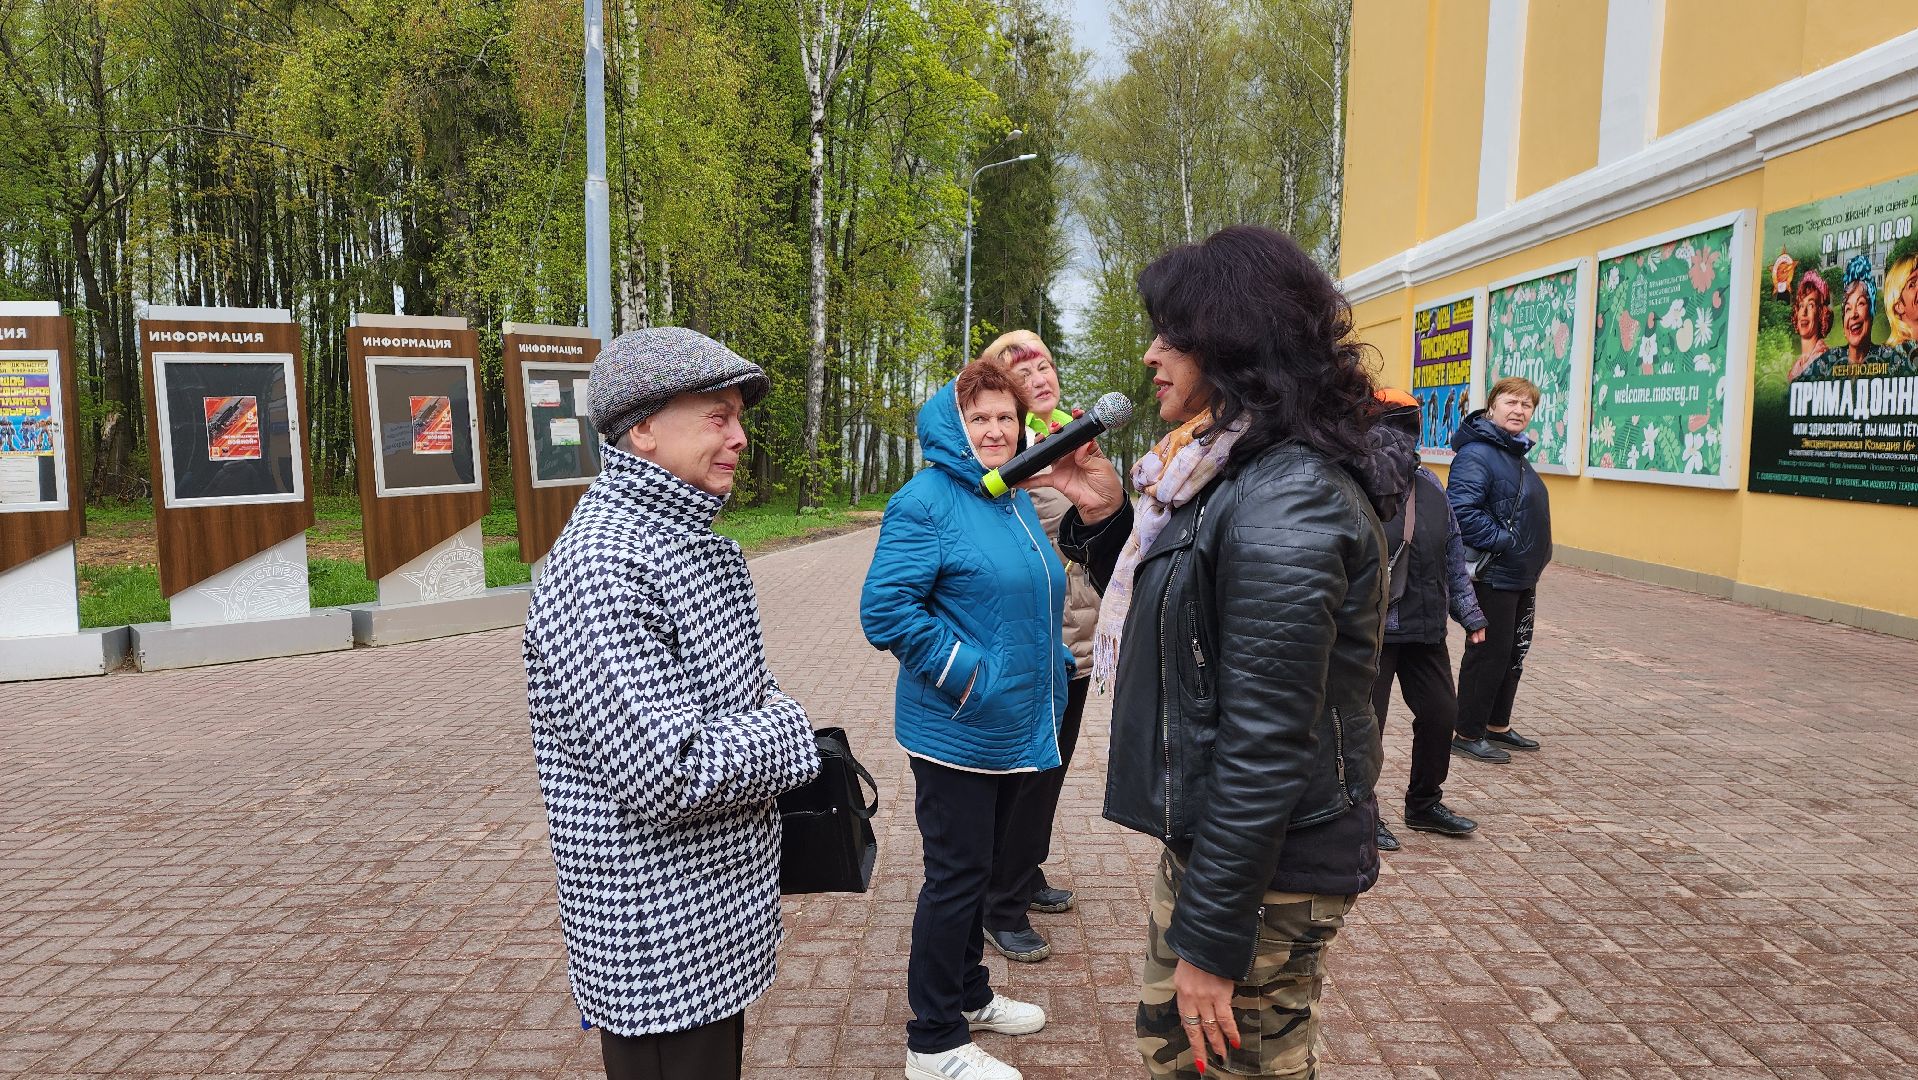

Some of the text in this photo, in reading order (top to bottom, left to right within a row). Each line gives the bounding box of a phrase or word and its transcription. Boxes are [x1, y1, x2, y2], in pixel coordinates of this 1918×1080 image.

[1782, 224, 1804, 237] Театр
[1874, 206, 1884, 216] на
[1885, 198, 1909, 213] сцене
[1822, 233, 1834, 254] 18
[1837, 226, 1863, 251] МАЯ
[1880, 215, 1912, 242] 18.00
[148, 330, 264, 344] ИНФОРМАЦИЯ
[362, 336, 452, 349] ИНФОРМАЦИЯ
[518, 343, 583, 355] ИНФОРМАЦИЯ
[1614, 383, 1700, 407] welcome.mosreg.ru
[1793, 420, 1918, 437] ИЛИ ЗДРАВСТВУЙТЕ, ВЫ НАША ТЁТ
[1864, 439, 1900, 452] Комедия
